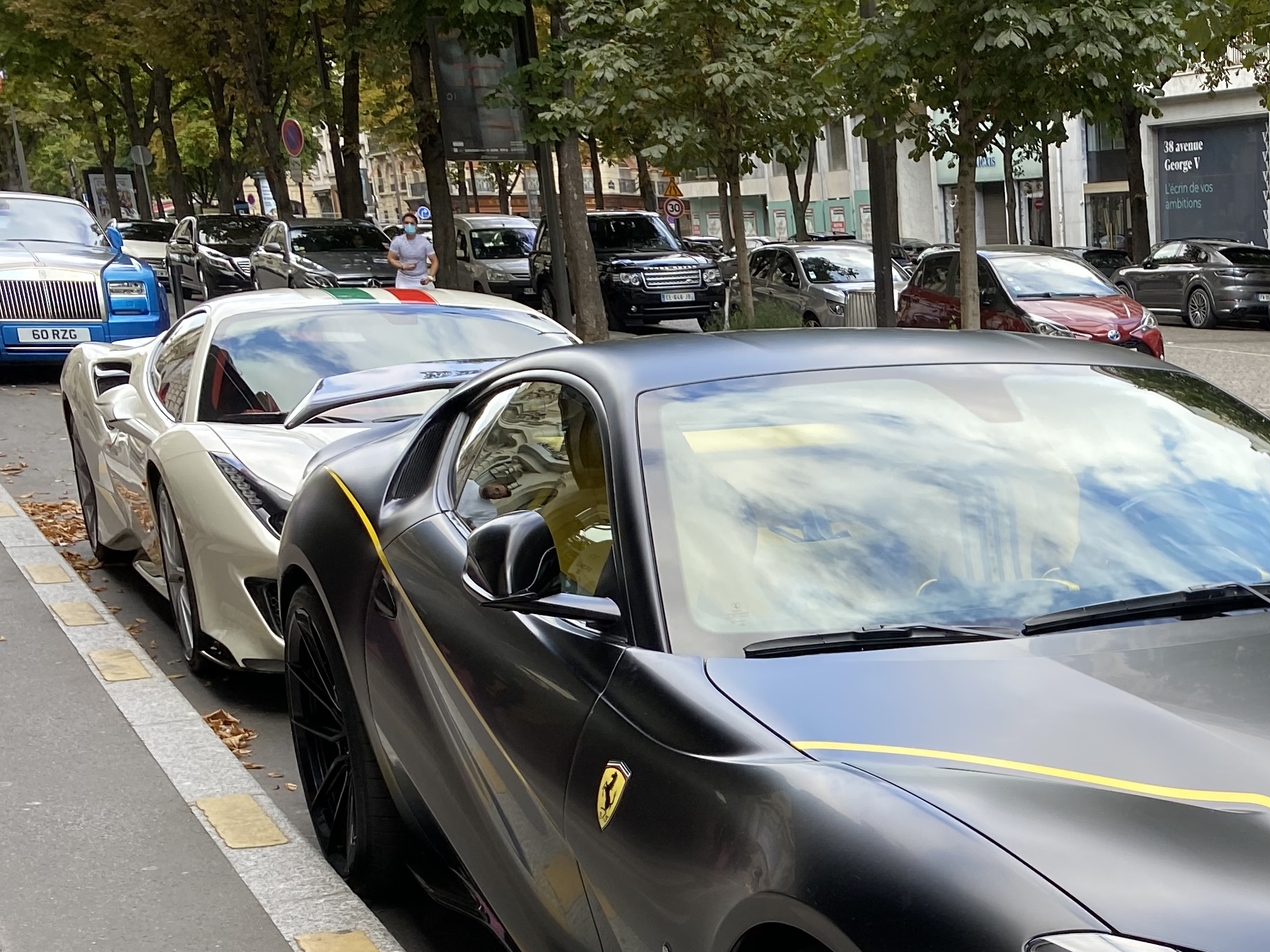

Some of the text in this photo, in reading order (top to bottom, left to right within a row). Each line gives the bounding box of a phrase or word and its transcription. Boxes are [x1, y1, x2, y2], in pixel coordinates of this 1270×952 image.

[1164, 140, 1204, 153] 38 avenue
[1164, 156, 1201, 173] George V
[1164, 182, 1213, 194] L'écrin de vos
[669, 204, 680, 212] 30
[1165, 198, 1201, 209] ambitions
[32, 329, 77, 339] 60 RZG
